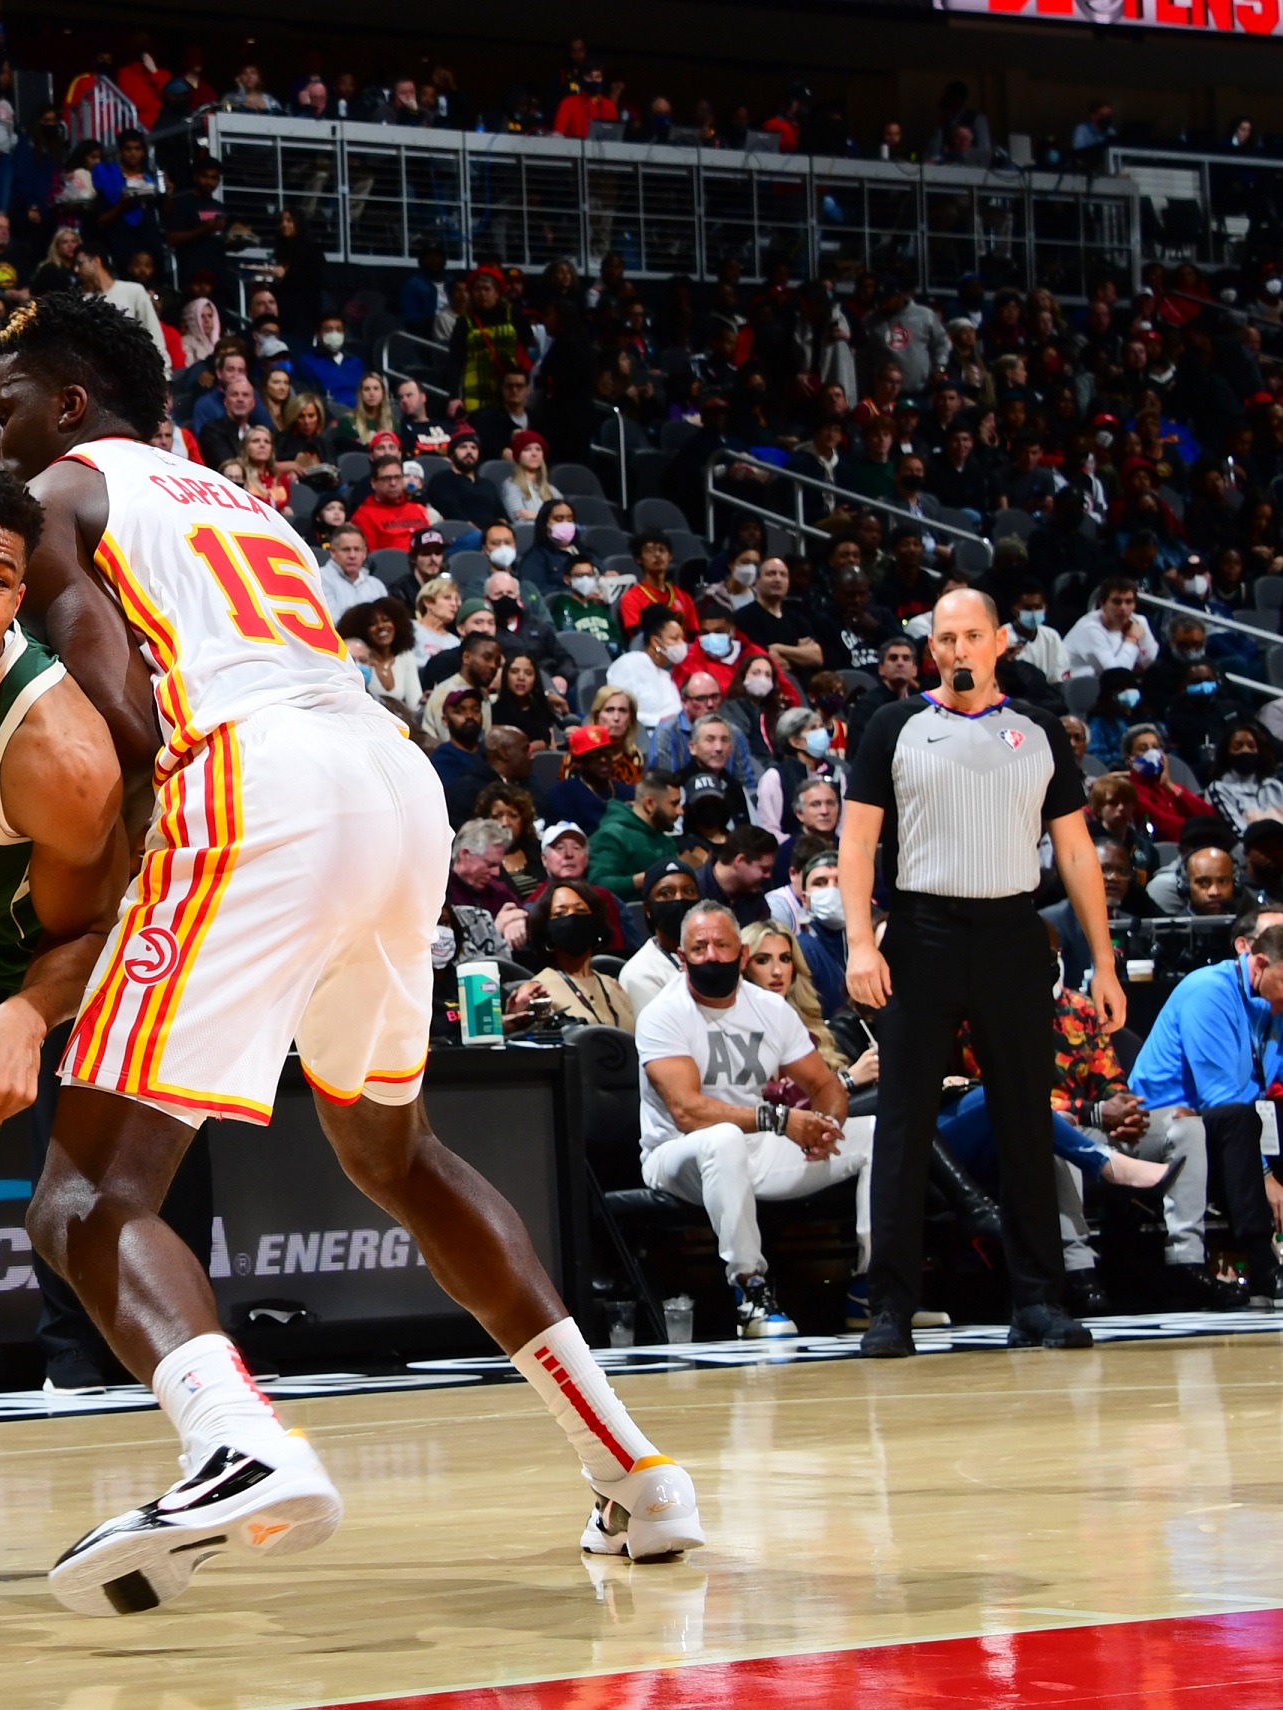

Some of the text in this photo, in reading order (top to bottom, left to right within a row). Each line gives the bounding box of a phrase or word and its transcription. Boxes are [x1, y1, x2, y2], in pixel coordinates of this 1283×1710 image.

[149, 474, 270, 523] CAPELA
[186, 523, 348, 662] 15
[703, 1031, 767, 1087] AX
